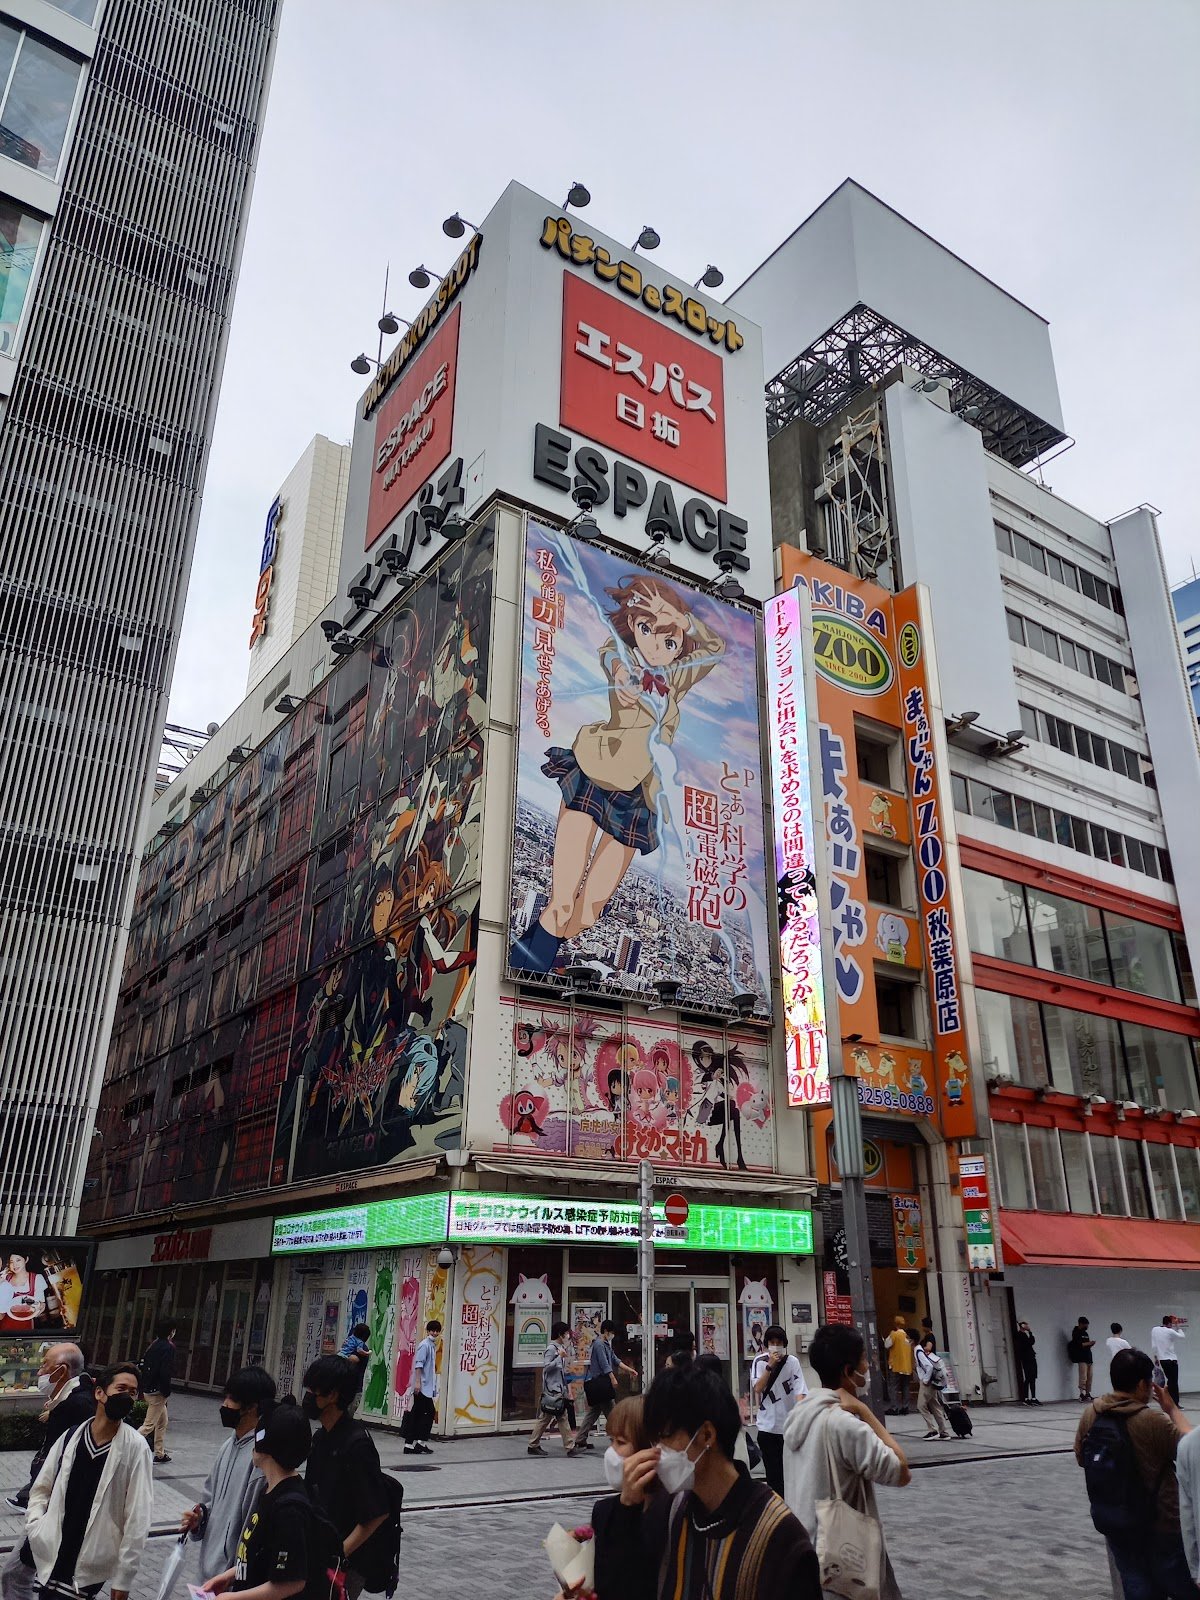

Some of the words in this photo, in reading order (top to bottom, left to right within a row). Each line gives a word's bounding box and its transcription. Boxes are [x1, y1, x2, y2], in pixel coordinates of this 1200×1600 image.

[575, 320, 717, 423] エスパス
[376, 361, 449, 474] ESPACE
[616, 392, 680, 448] 日拓
[534, 423, 750, 572] ESPACE
[794, 574, 887, 637] AKIBA
[822, 622, 865, 646] MAHJONG
[812, 626, 881, 678] ZOO
[824, 660, 847, 675] SINCE
[848, 669, 868, 683] 2001
[900, 623, 917, 664] ZOO
[905, 686, 934, 798] まぁじゃん
[744, 768, 755, 788] P
[684, 785, 723, 930] 超電磁砲
[719, 761, 749, 912] とある科学の
[917, 799, 947, 904] ZOO
[927, 907, 961, 1035] 秋葉原店
[791, 1072, 831, 1103] 20台
[340, 1181, 358, 1191] ESPACE
[655, 1176, 678, 1185] ESPACE
